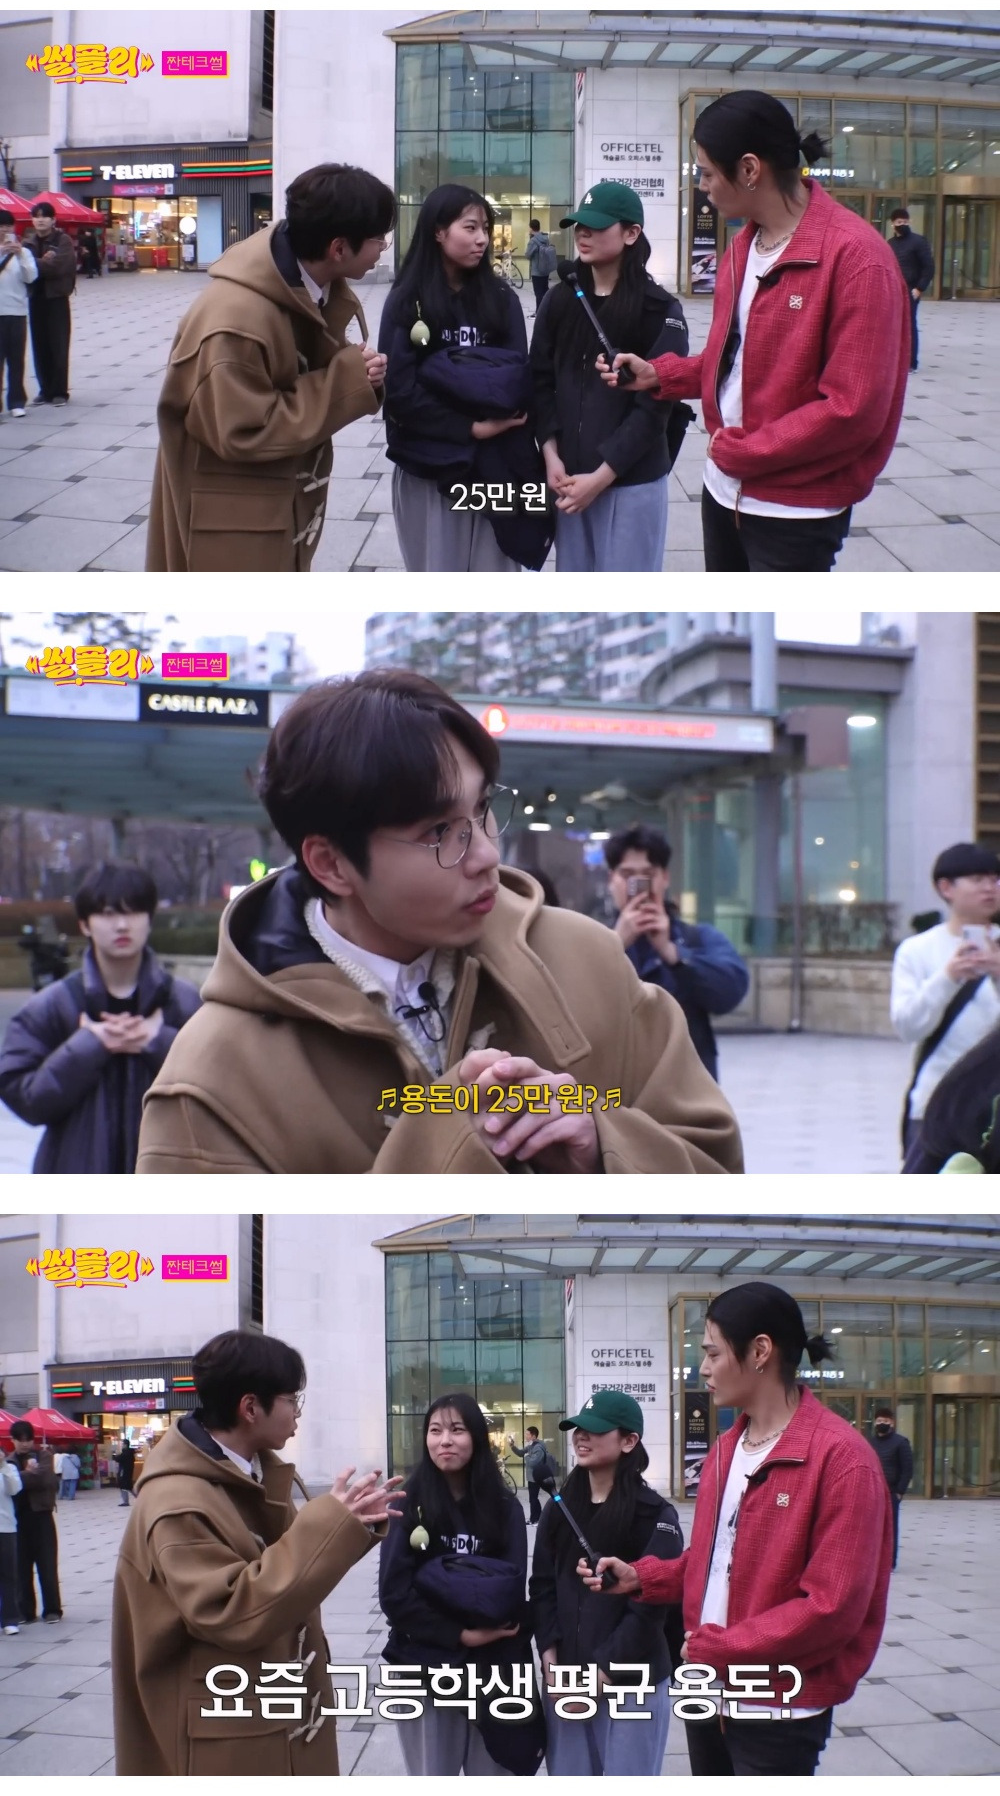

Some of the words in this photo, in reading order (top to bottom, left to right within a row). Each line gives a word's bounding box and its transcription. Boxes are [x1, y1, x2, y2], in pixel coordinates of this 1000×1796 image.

[600, 143, 664, 153] OFFICETEL
[100, 163, 174, 181] 7-ELEVEN
[148, 693, 206, 713] CASTLE
[207, 696, 258, 715] PLAZA
[591, 1348, 654, 1359] OFFICETEL
[90, 1378, 165, 1396] 7-ELEVEN
